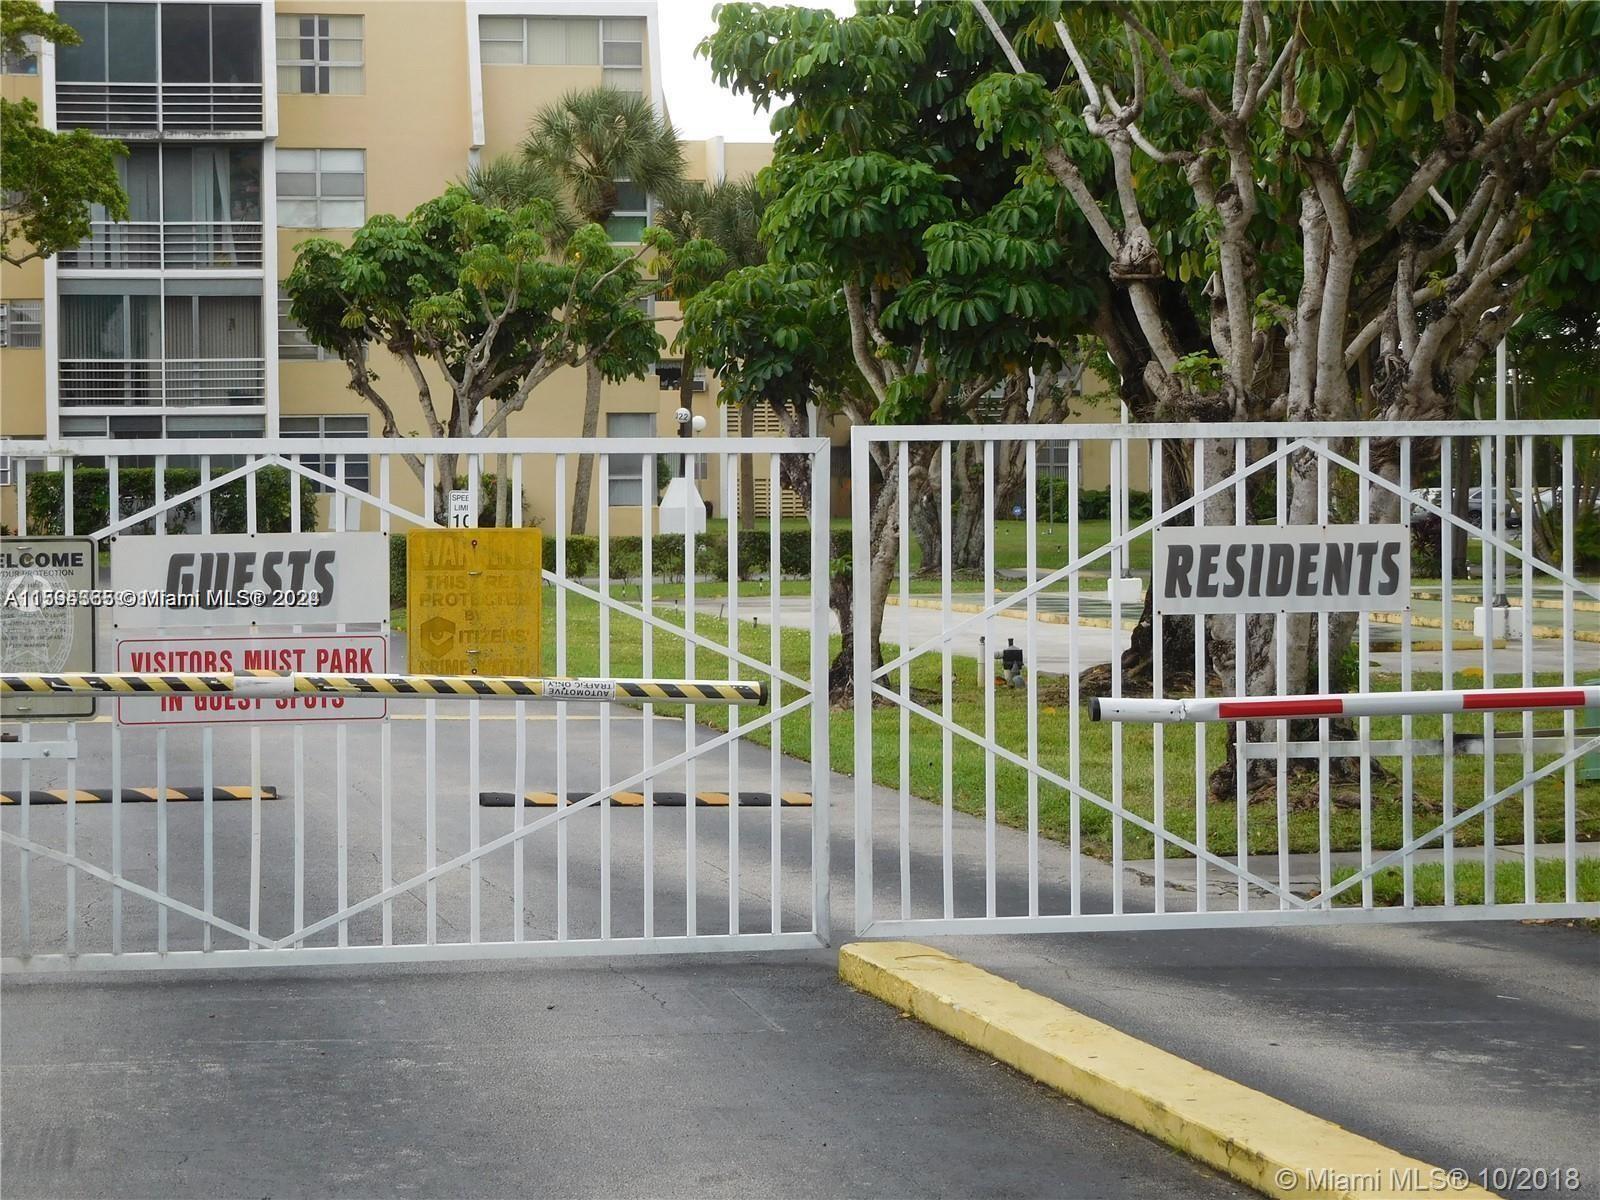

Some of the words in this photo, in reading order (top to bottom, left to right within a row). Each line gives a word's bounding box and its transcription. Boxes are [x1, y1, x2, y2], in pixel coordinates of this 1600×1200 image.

[451, 494, 469, 502] SPEE
[0, 552, 84, 568] LCOME
[22, 569, 74, 578] PROTECTION
[1164, 540, 1401, 599] RESIDENTS
[166, 549, 337, 611] GUESTS
[473, 575, 524, 590] REA
[419, 592, 530, 607] PROTETED
[131, 650, 233, 673] VISITORS
[244, 649, 306, 672] MUST
[316, 647, 374, 673] PARK
[549, 688, 609, 697] AUTOMOTIVE
[575, 682, 612, 690] TRAFFIC
[161, 694, 182, 712] IN
